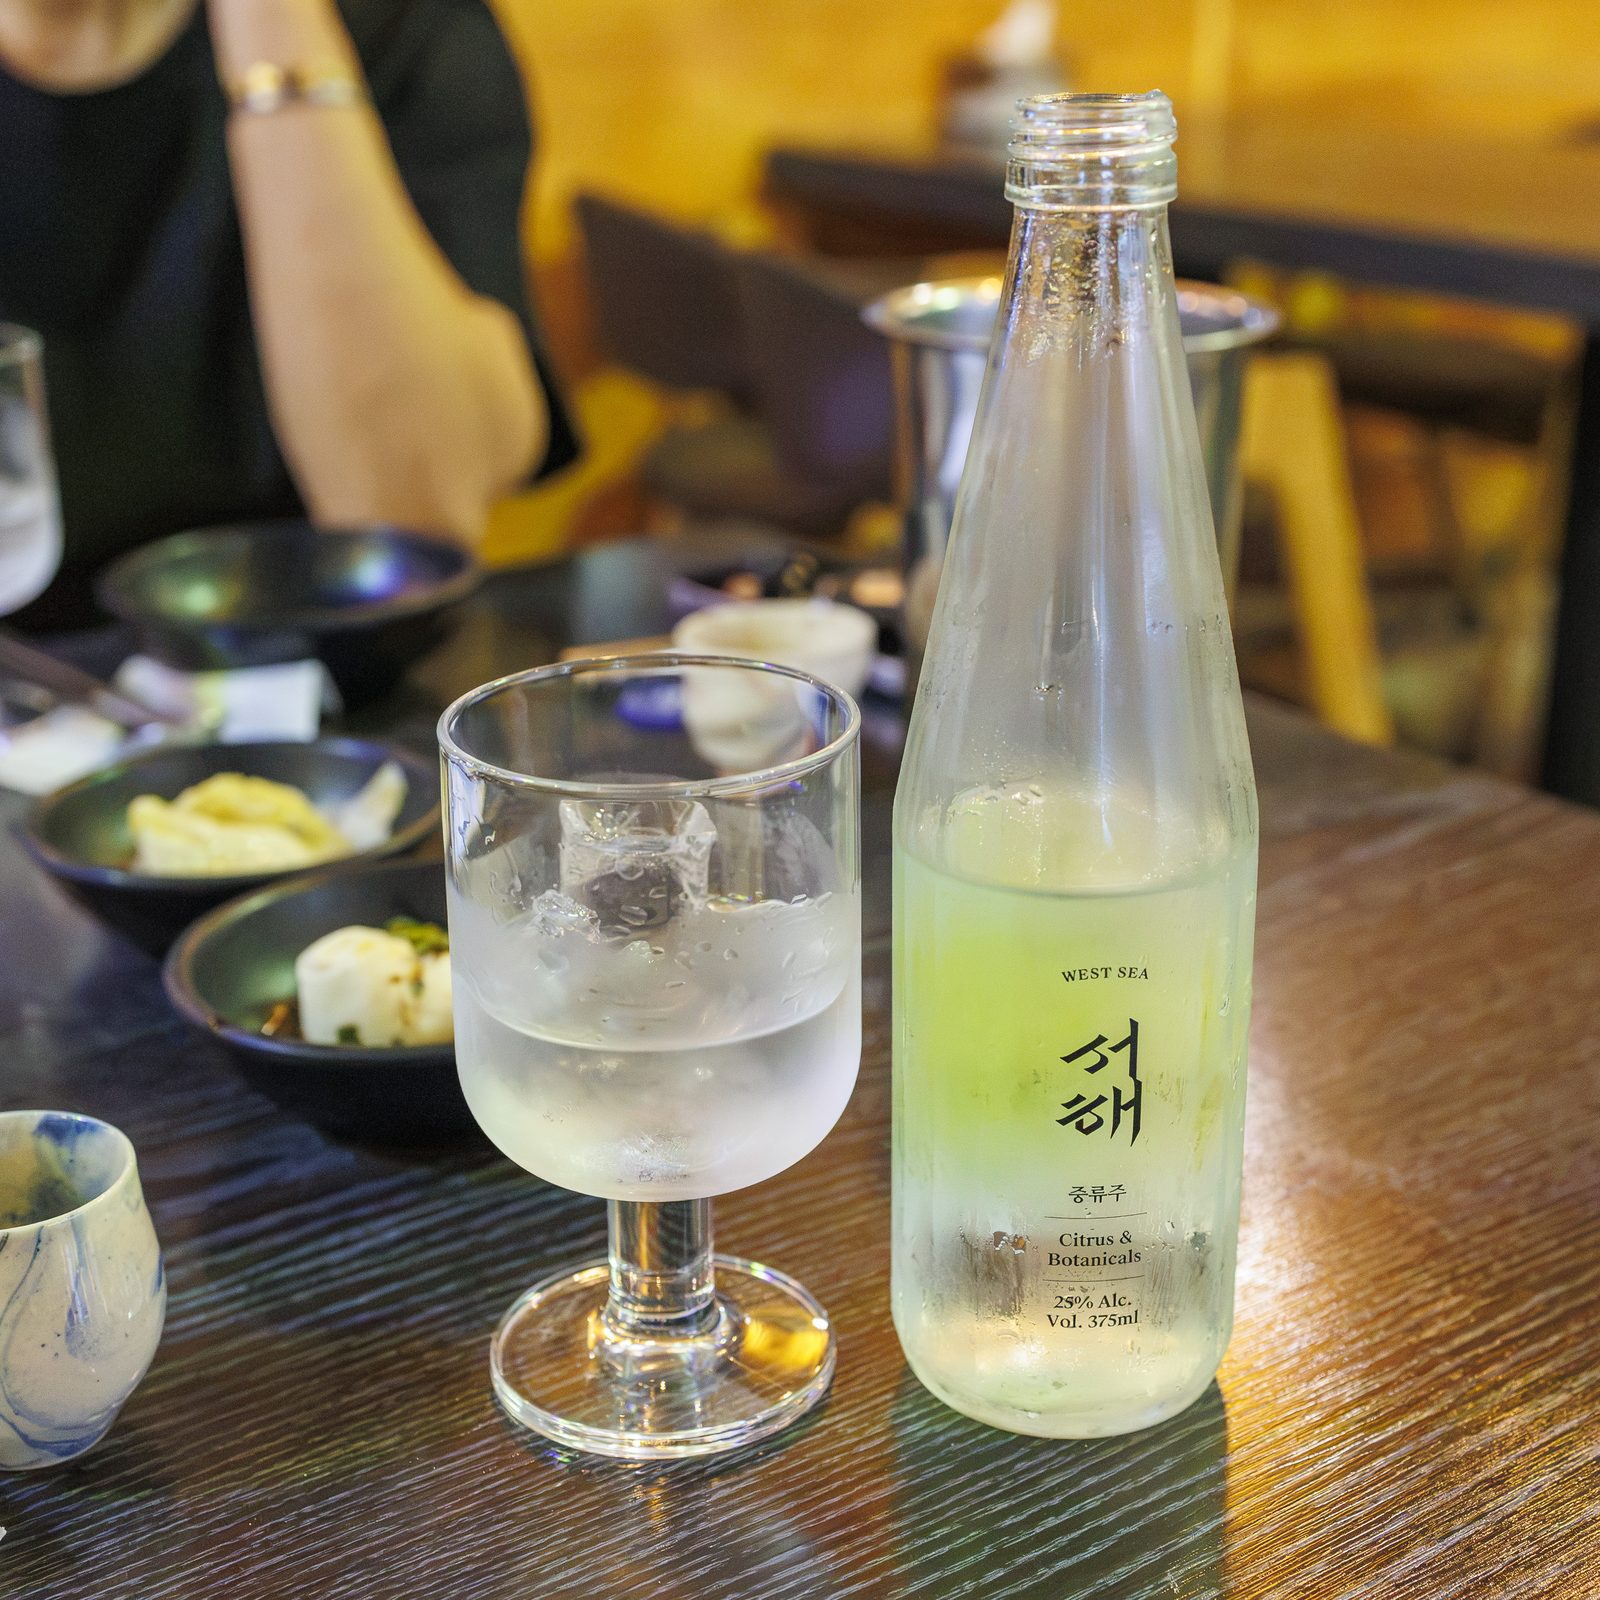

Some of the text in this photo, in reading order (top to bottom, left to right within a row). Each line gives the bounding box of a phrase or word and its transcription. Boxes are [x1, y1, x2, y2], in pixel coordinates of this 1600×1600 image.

[1061, 966, 1149, 983] WEST SEA
[1055, 1017, 1142, 1147] 서해
[1059, 1230, 1132, 1247] Citrus &
[1048, 1249, 1142, 1267] Botanicals
[1054, 1293, 1132, 1309] 25% Alc.
[1047, 1309, 1139, 1328] Vol. 375ml
